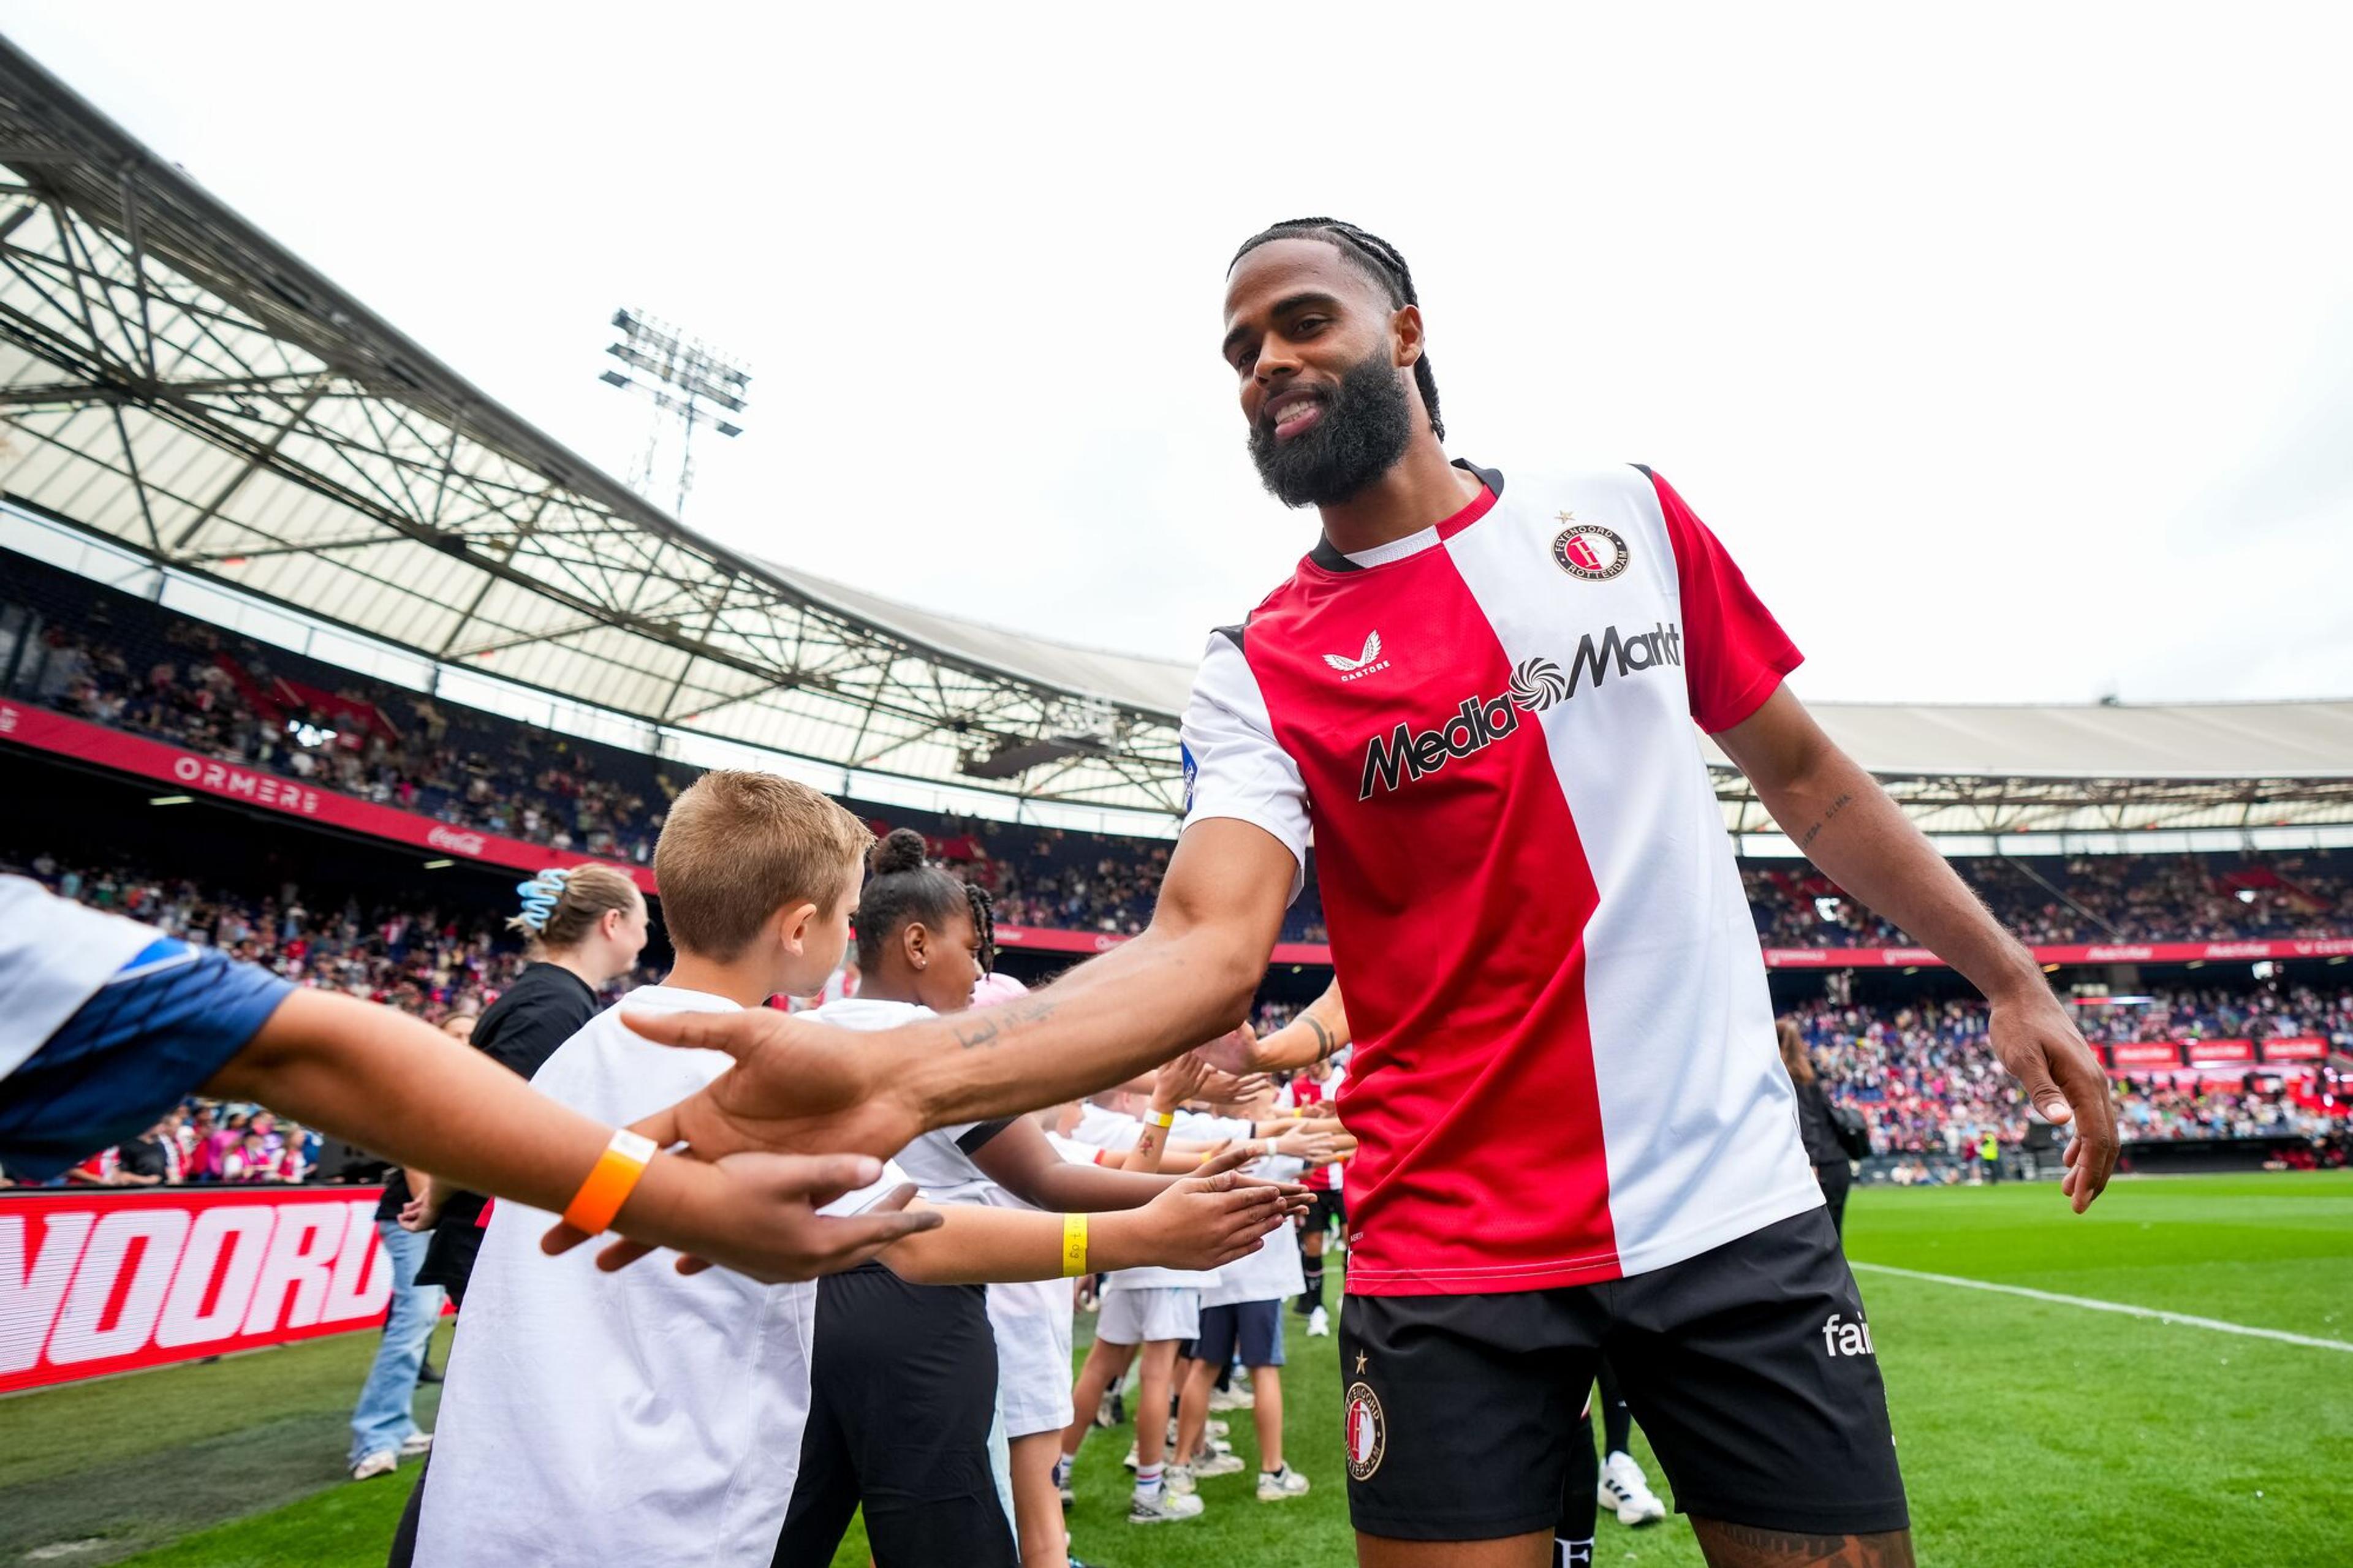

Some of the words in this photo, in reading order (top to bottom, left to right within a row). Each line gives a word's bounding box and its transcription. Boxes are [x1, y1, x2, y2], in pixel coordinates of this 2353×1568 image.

[1555, 525, 1613, 552] FEYENOORD
[1567, 550, 1628, 579] ROTTERDAM
[1341, 660, 1390, 681] CASTORE
[1358, 691, 1518, 801] Media
[1564, 622, 1681, 700] Markt
